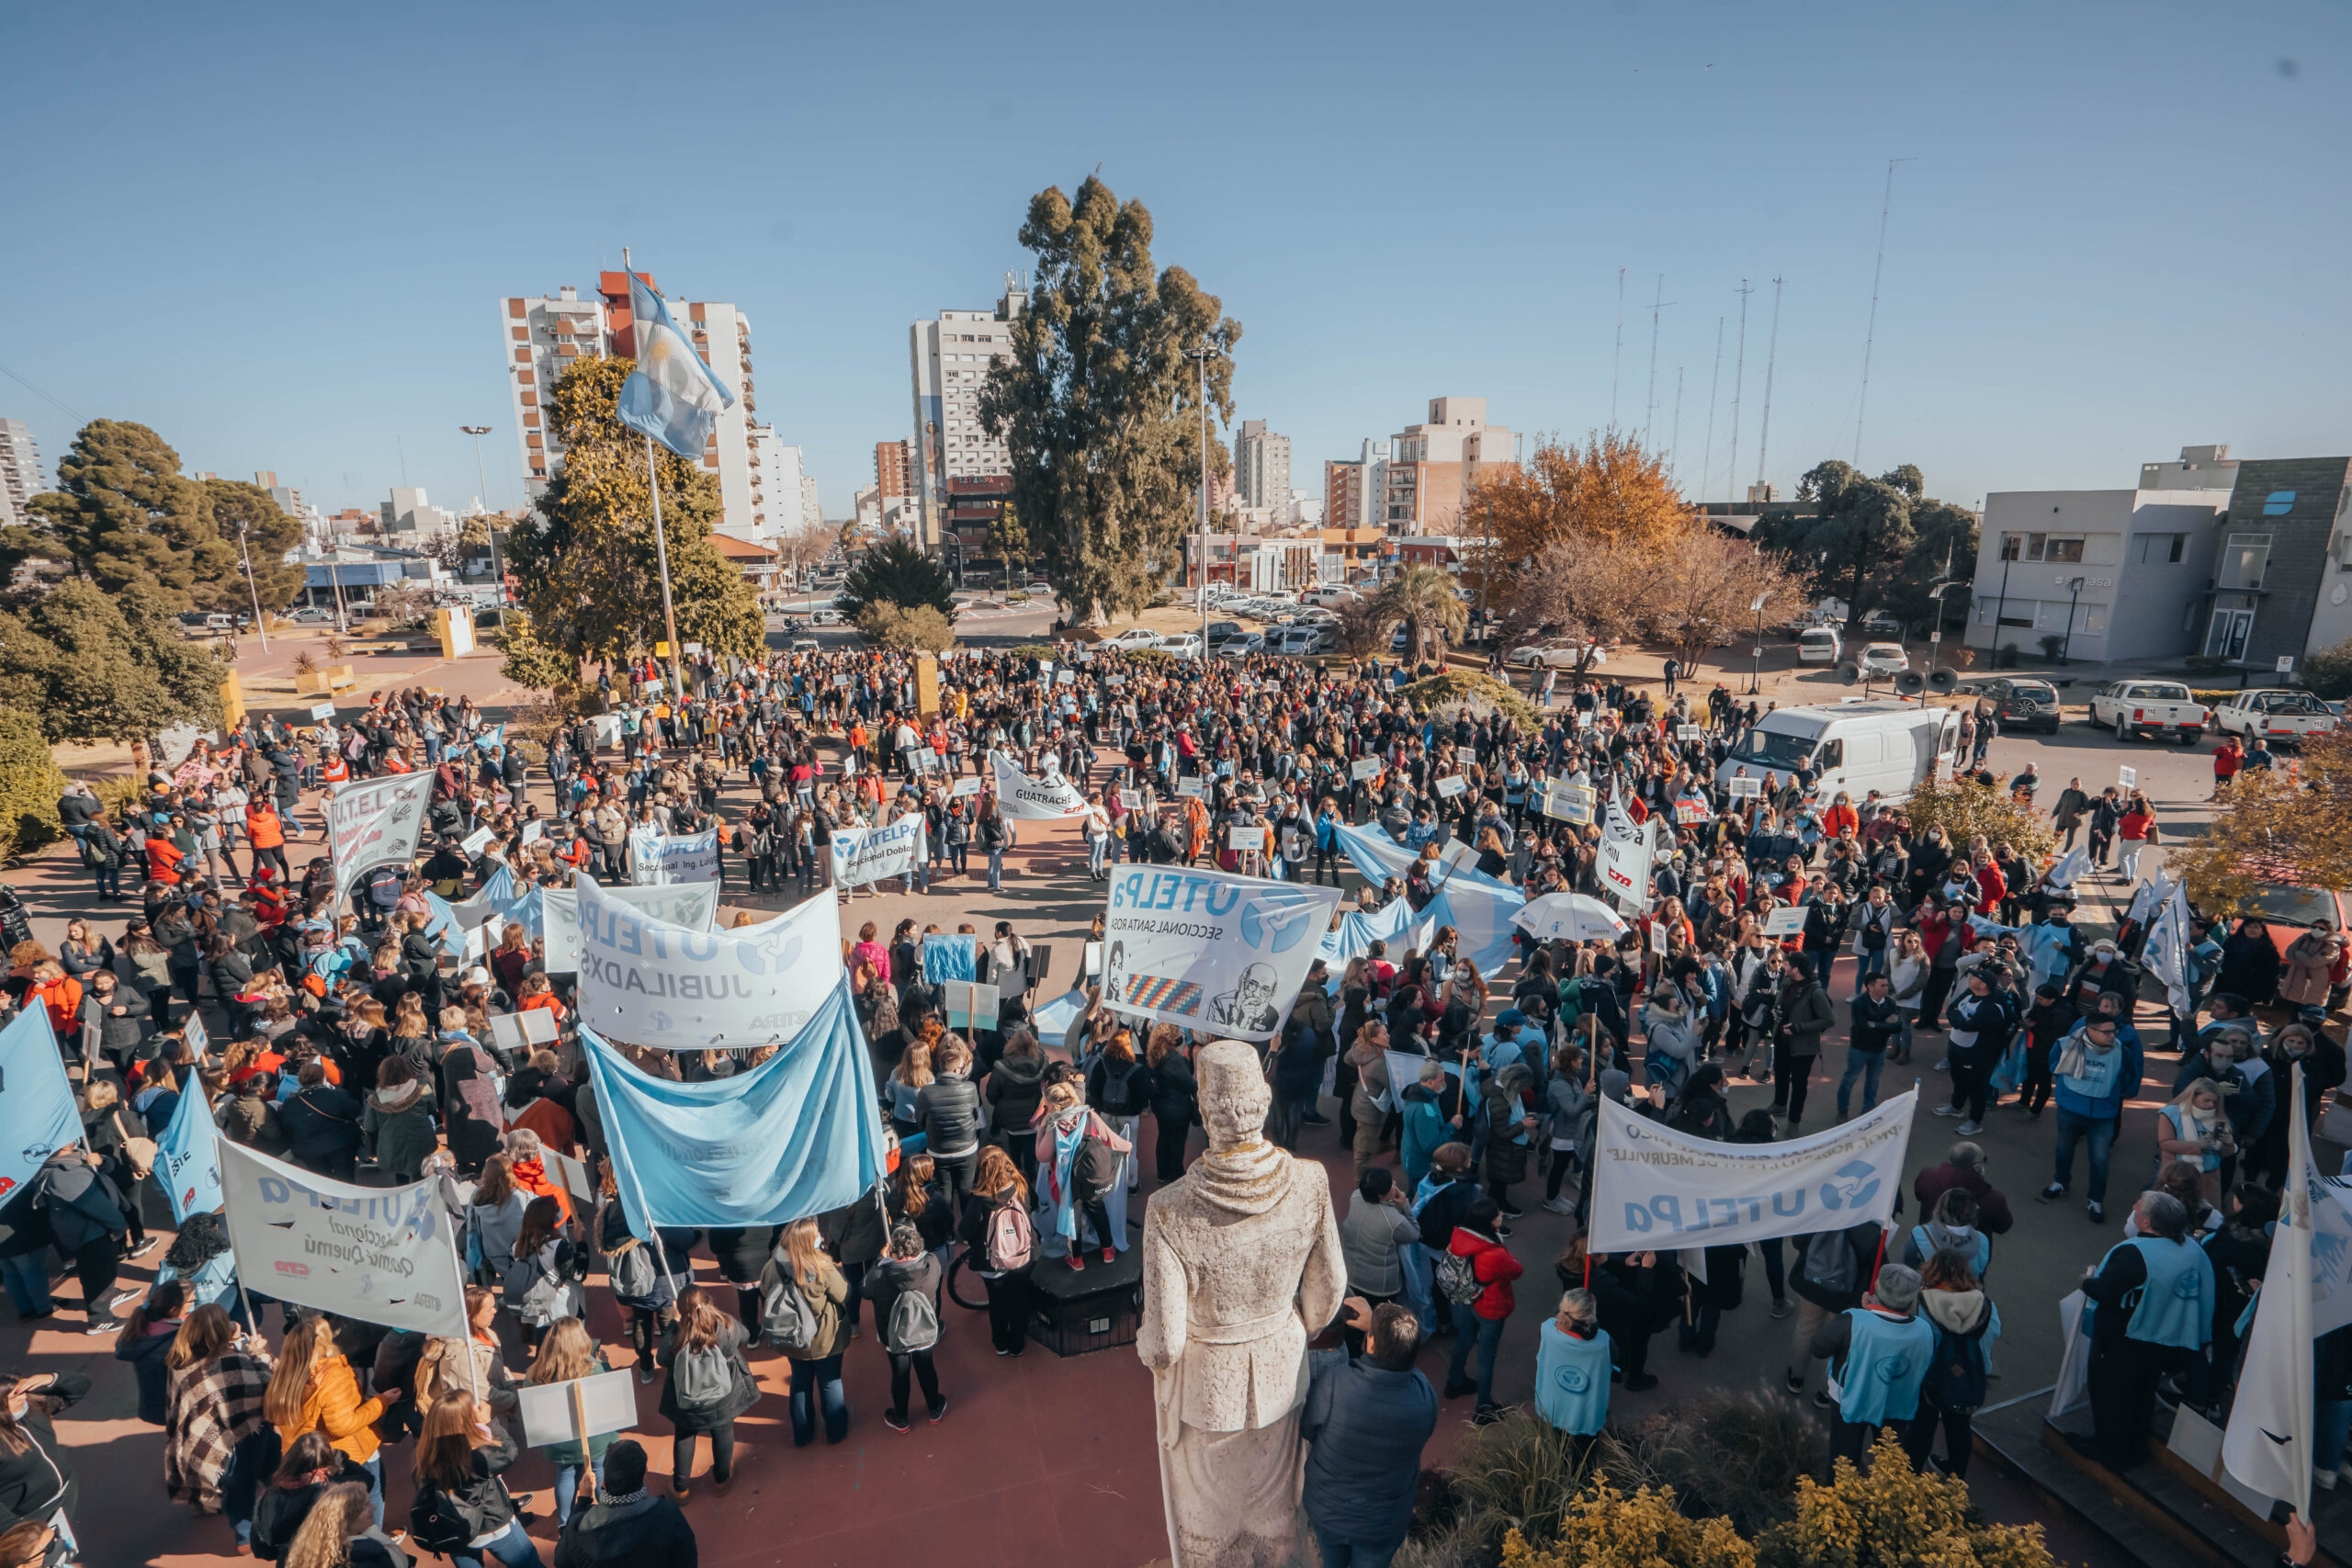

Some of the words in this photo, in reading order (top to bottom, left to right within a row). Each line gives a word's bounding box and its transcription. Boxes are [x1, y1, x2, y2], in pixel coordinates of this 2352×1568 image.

[2065, 576, 2111, 587] sasa
[1015, 789, 1072, 805] GUATRACHE
[638, 860, 678, 872] Seccional
[683, 860, 697, 871] Ing.
[847, 850, 885, 868] Seccional
[1609, 868, 1633, 888] CTA
